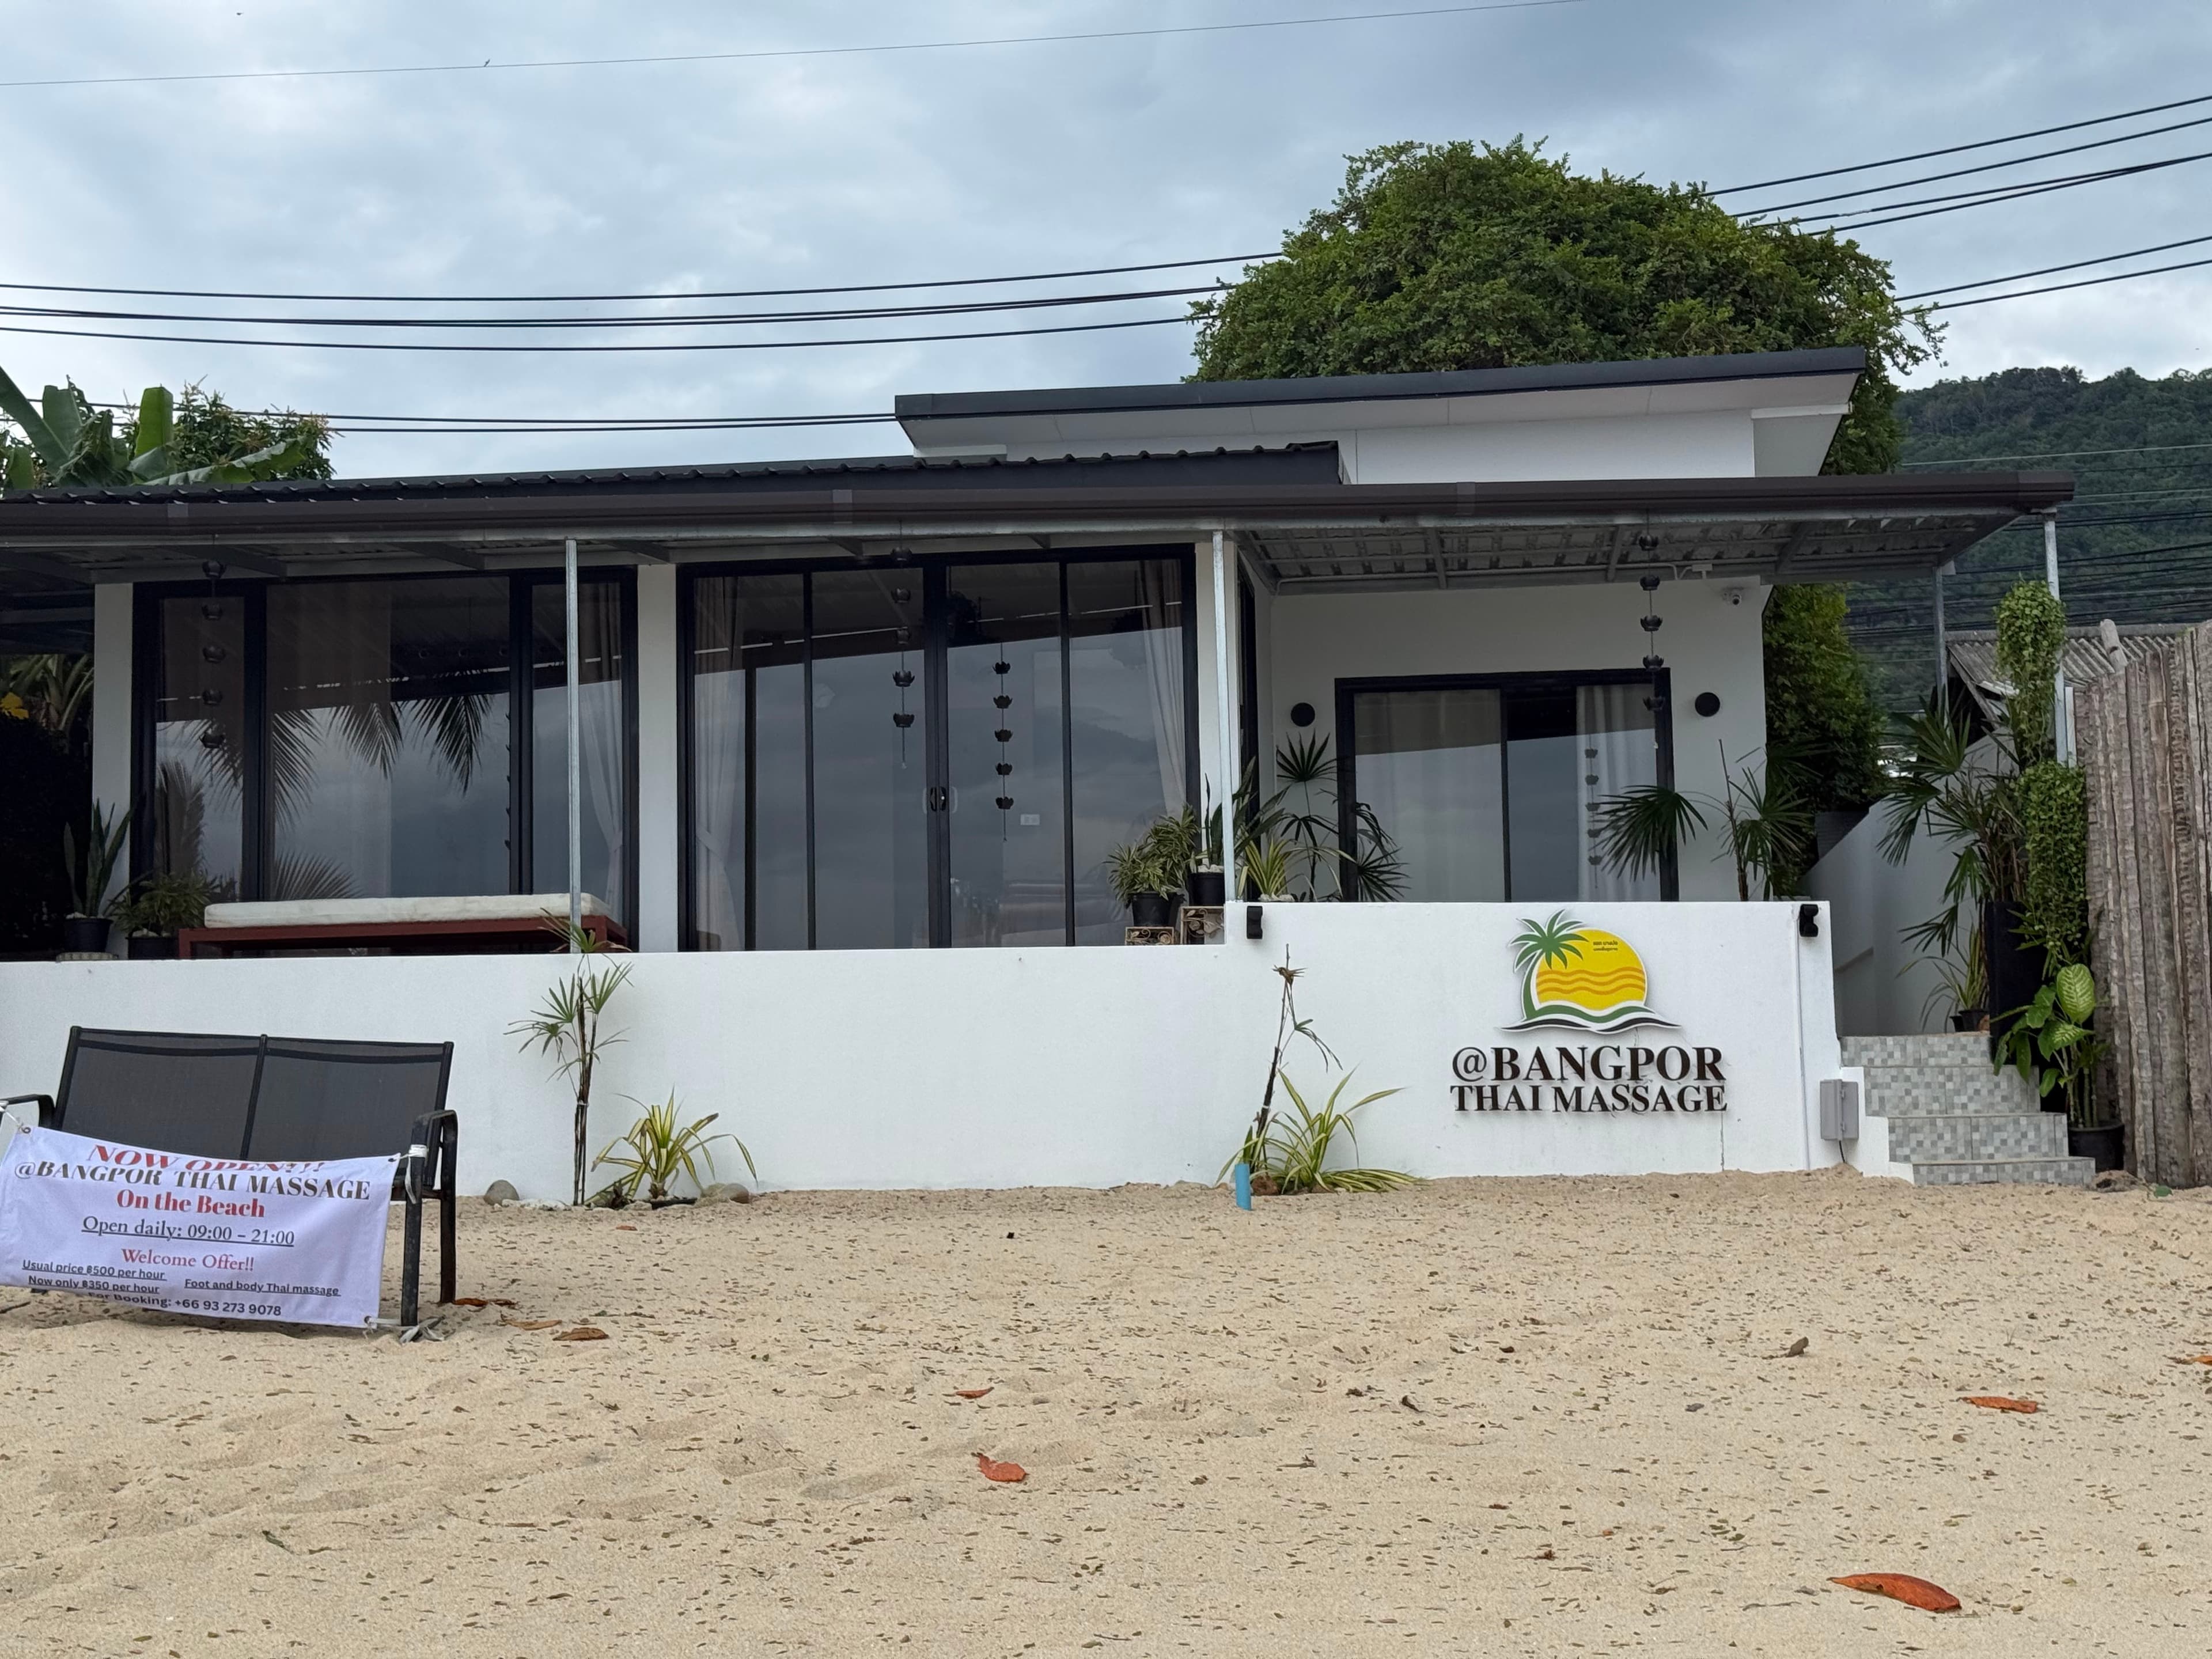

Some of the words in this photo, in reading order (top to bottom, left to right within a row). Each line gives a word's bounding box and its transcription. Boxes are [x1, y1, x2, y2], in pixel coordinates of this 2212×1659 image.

[1452, 1044, 1726, 1082] @BANGPOR
[1450, 1084, 1542, 1112] THAI
[1552, 1083, 1728, 1112] MASSAGE
[86, 1145, 181, 1169] NOW
[14, 1161, 162, 1186] @BANGPOR
[173, 1171, 238, 1191] THAI
[246, 1175, 370, 1200] MASSAGE
[117, 1189, 149, 1210] On
[154, 1191, 191, 1213] the
[197, 1195, 265, 1218] Beach
[82, 1215, 128, 1236] Open
[134, 1218, 182, 1241] daily:
[187, 1224, 232, 1240] 09:00
[251, 1229, 295, 1247] 21:00
[22, 1259, 53, 1274] Usual
[55, 1262, 84, 1275] price
[118, 1269, 137, 1279] per
[139, 1268, 165, 1281] hour
[122, 1248, 196, 1267] Welcome
[202, 1253, 255, 1271] Offer!!
[29, 1275, 52, 1286] Now
[55, 1278, 79, 1290] only
[112, 1284, 131, 1293] per
[134, 1284, 160, 1294] hour
[184, 1279, 210, 1289] Foot
[213, 1281, 233, 1290] and
[236, 1281, 264, 1293] body
[292, 1285, 341, 1297] massage
[113, 1294, 172, 1308] Booking:
[175, 1300, 199, 1309] +66
[203, 1301, 219, 1311] 93
[222, 1302, 245, 1313] 273
[248, 1304, 282, 1316] 9078
